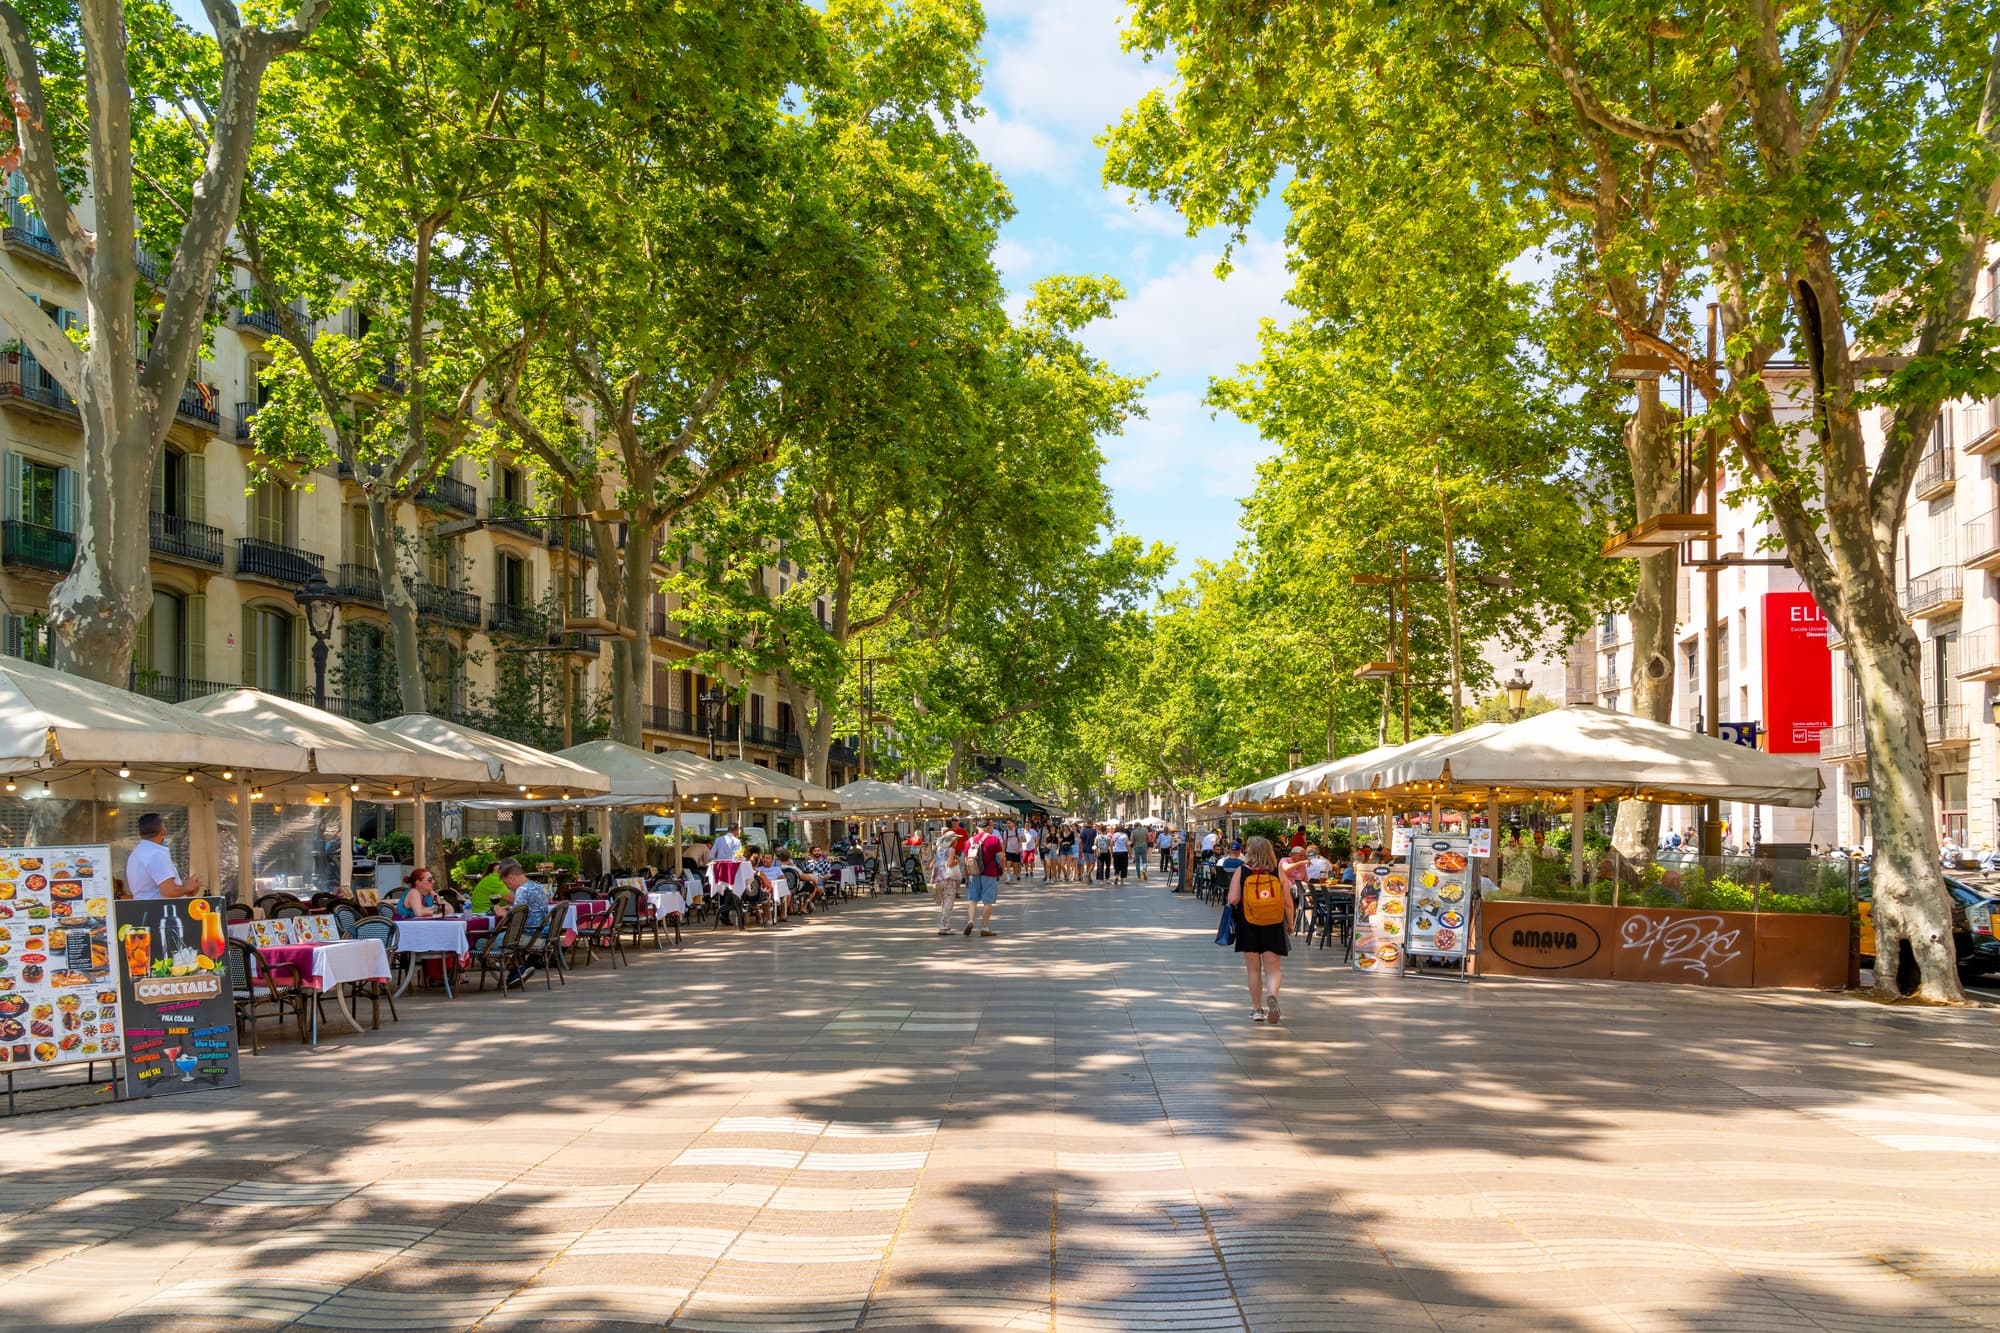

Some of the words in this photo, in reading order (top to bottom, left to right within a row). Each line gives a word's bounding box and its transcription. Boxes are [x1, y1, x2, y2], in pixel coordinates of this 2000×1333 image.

[1791, 606, 1828, 621] ELI
[1512, 930, 1577, 949] AMAYA
[138, 980, 217, 997] COCKTAILS
